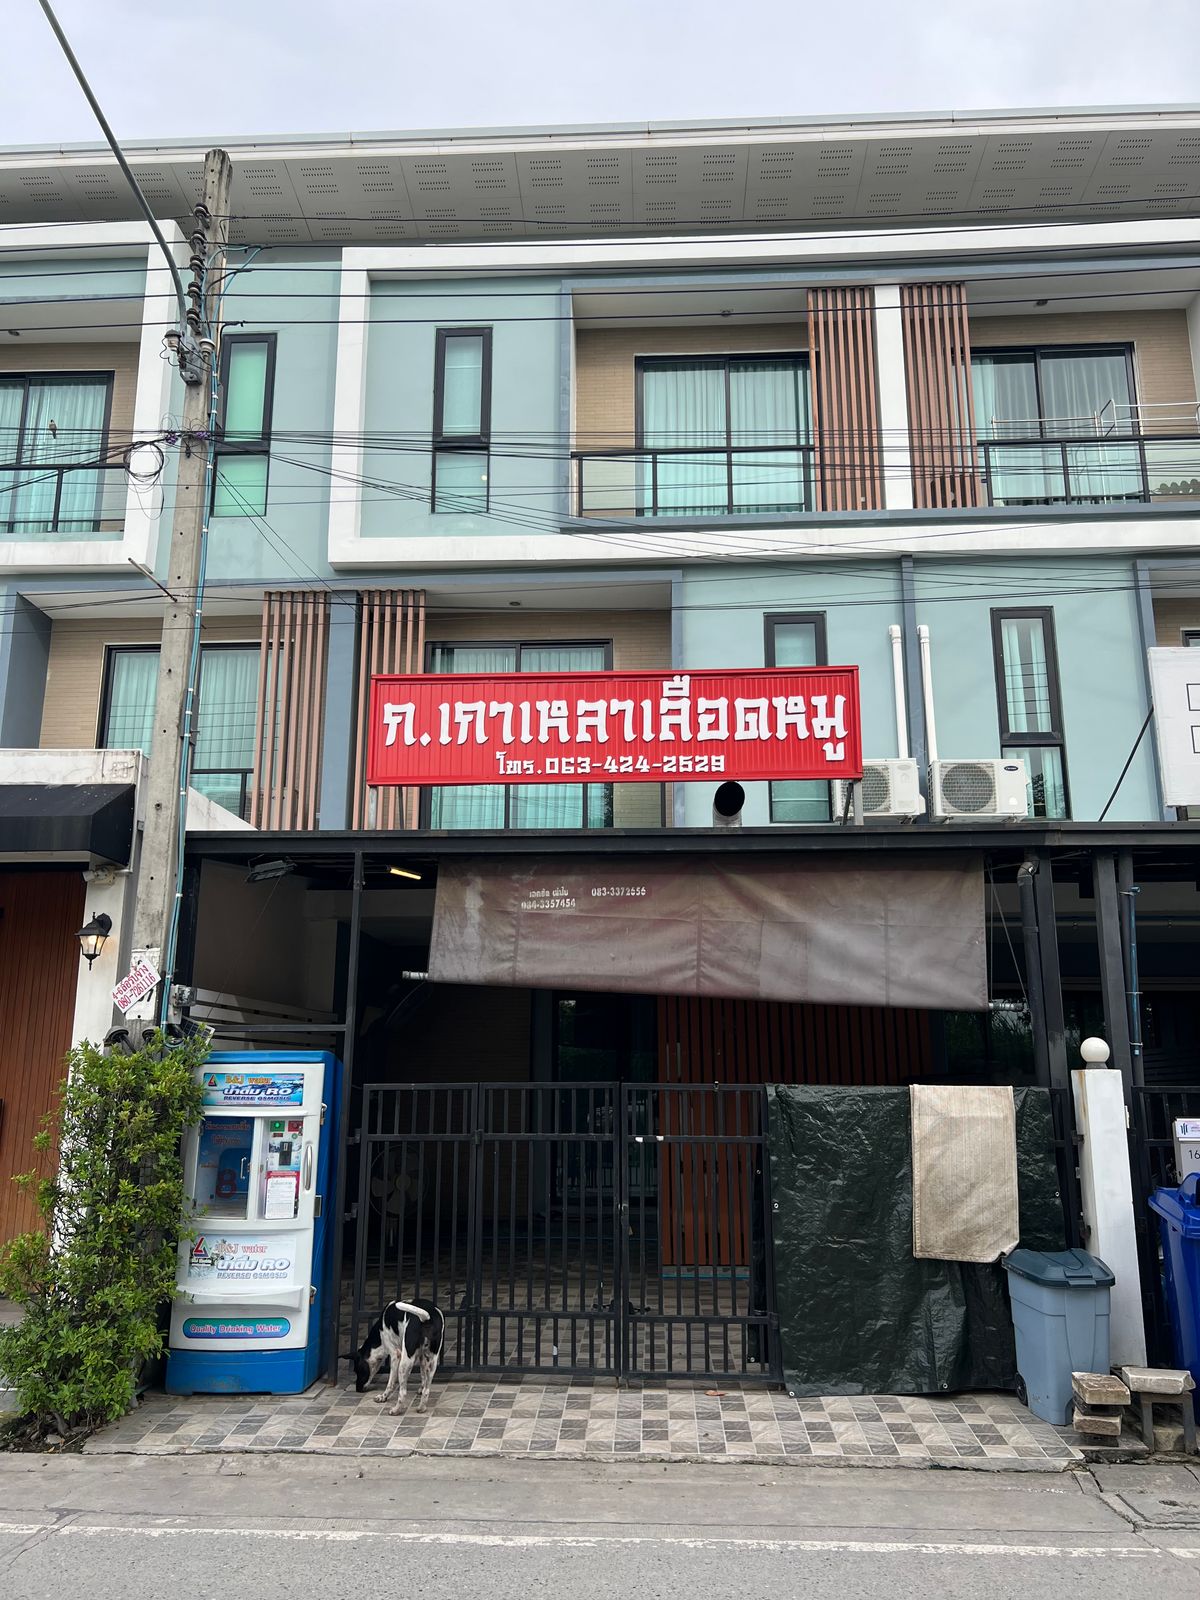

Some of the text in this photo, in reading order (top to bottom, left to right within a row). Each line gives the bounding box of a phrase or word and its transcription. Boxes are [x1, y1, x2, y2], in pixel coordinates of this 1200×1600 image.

[265, 1087, 293, 1096] RO
[261, 1258, 291, 1271] RO
[190, 1323, 282, 1335] Quality Drinking Water
